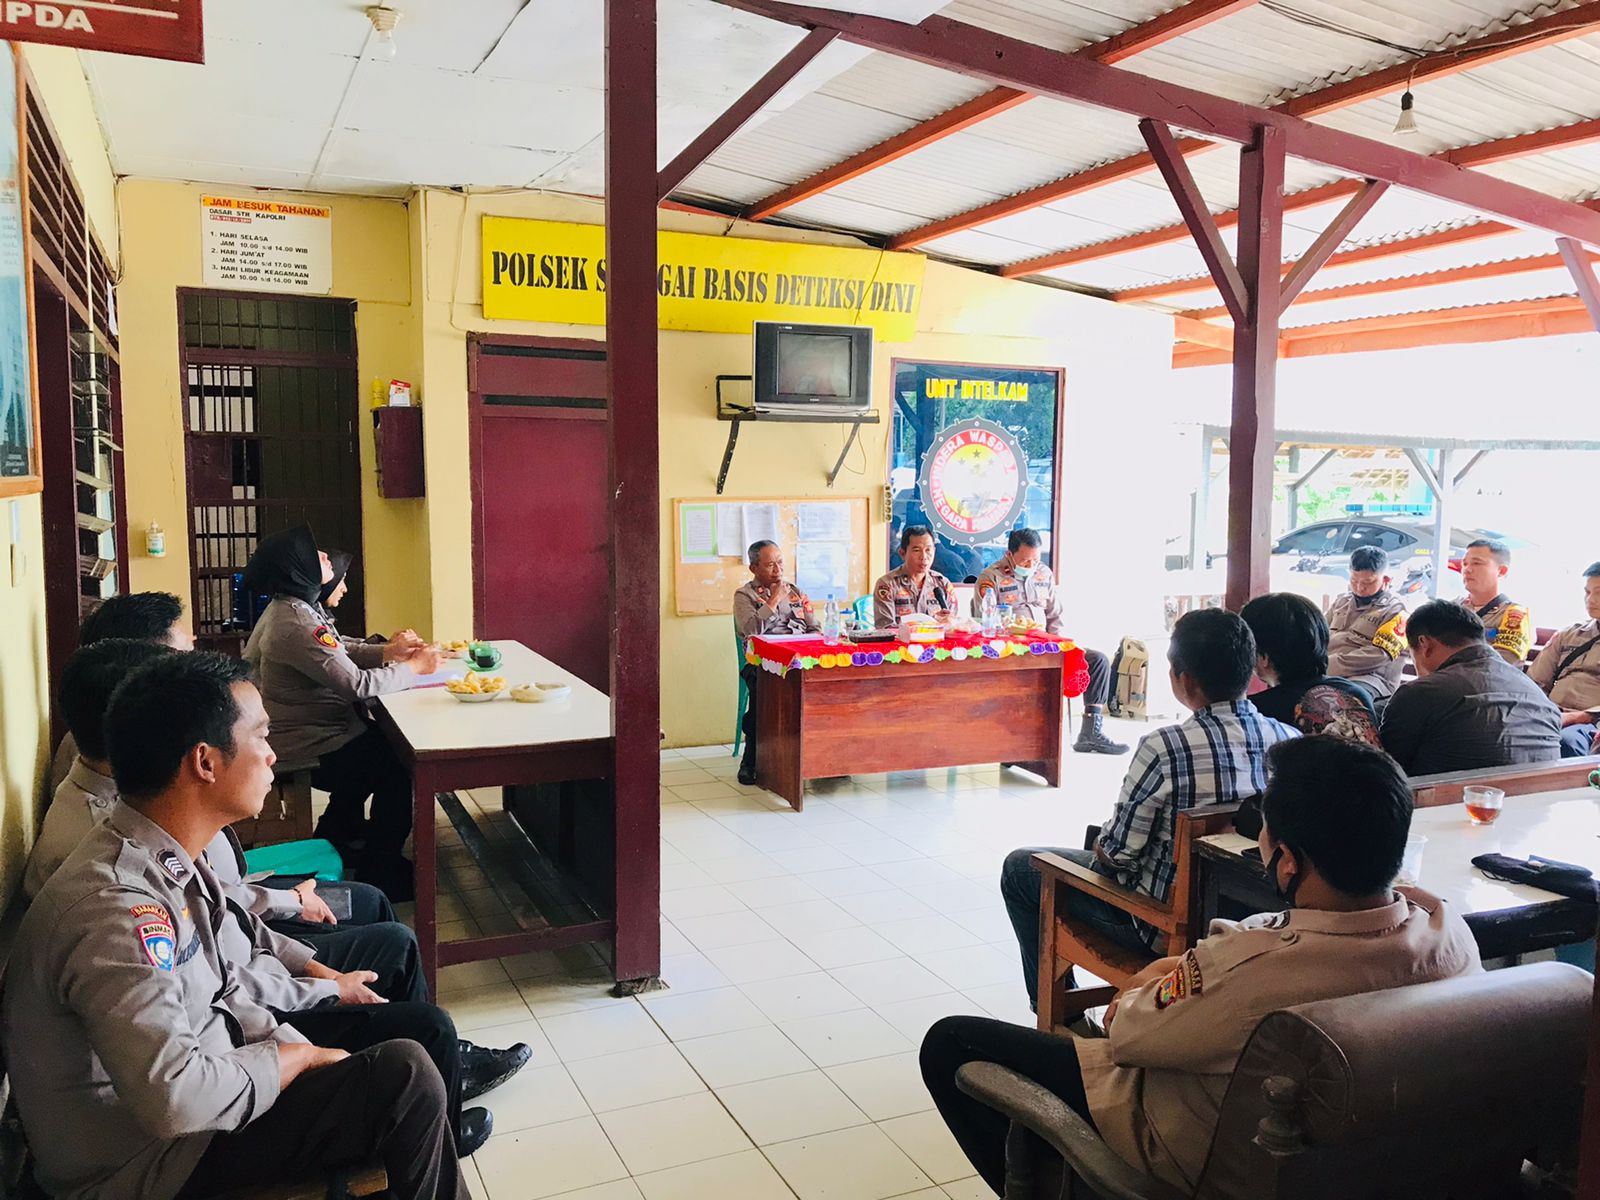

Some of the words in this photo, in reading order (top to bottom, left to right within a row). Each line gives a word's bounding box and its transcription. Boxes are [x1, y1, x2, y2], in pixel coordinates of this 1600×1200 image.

[0, 1, 95, 33] PDA
[209, 198, 232, 207] JAM
[237, 201, 272, 211] BESUK
[275, 204, 325, 217] TAHANAN
[240, 234, 269, 242] SELASA
[239, 250, 265, 258] JUM'AT
[264, 270, 309, 279] KEAGAMAAN
[491, 250, 588, 291] POLSEK
[703, 267, 768, 304] BASIS
[775, 273, 867, 311] DETEKSI
[868, 281, 917, 315] DINI
[926, 378, 958, 400] UNIT
[961, 379, 1029, 402] INTELKAM
[932, 487, 968, 531] NEGARA
